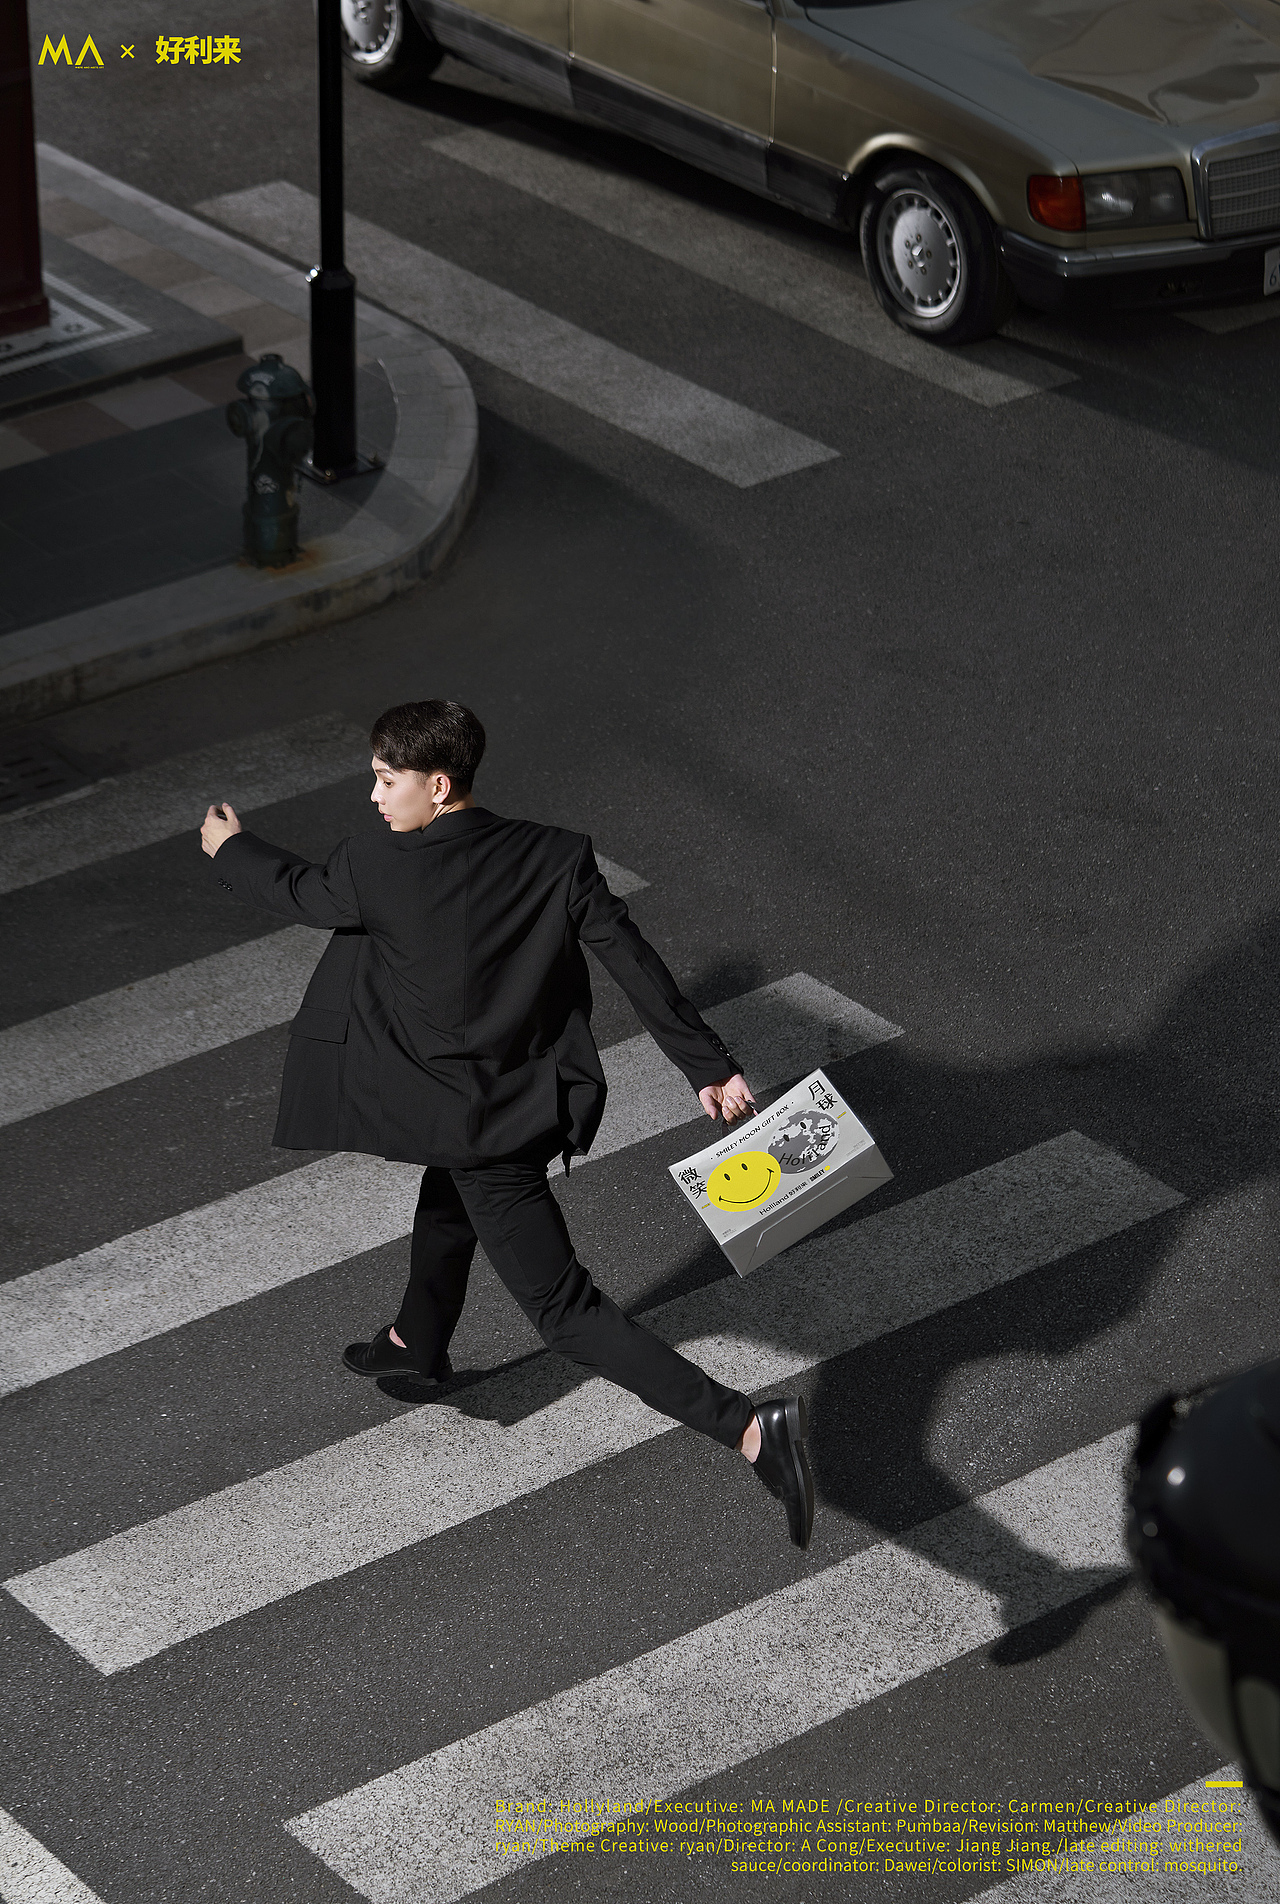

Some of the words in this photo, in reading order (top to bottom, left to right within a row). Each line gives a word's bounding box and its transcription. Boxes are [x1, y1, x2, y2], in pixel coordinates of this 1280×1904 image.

[807, 1079, 838, 1112] 月球
[715, 1140, 738, 1158] SMILEY
[738, 1125, 761, 1144] MOON
[761, 1114, 775, 1128] GIFT
[775, 1104, 790, 1118] BOX
[677, 1166, 708, 1200] 微笑
[759, 1194, 789, 1216] Holiland
